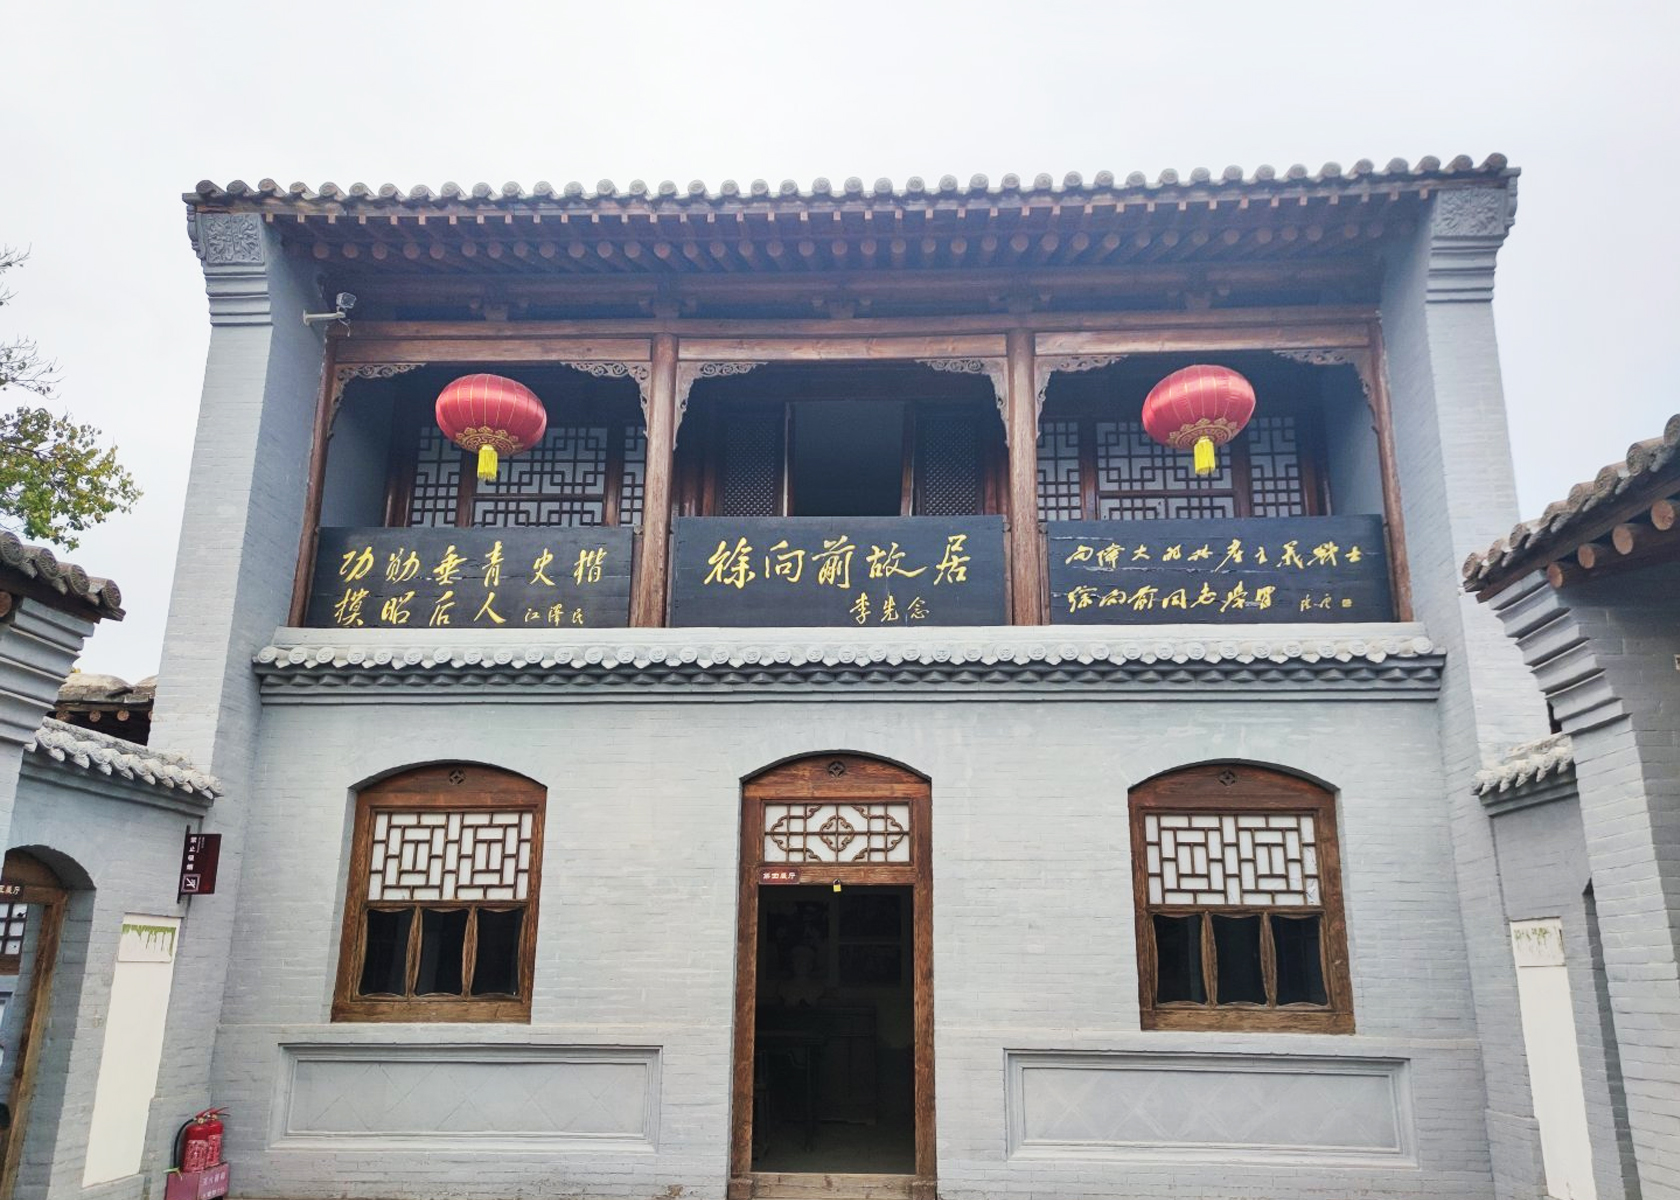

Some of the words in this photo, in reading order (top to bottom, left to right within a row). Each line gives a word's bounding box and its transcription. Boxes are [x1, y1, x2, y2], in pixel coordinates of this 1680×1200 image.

[704, 535, 972, 589] 徐向前故居
[849, 592, 930, 625] 李先念
